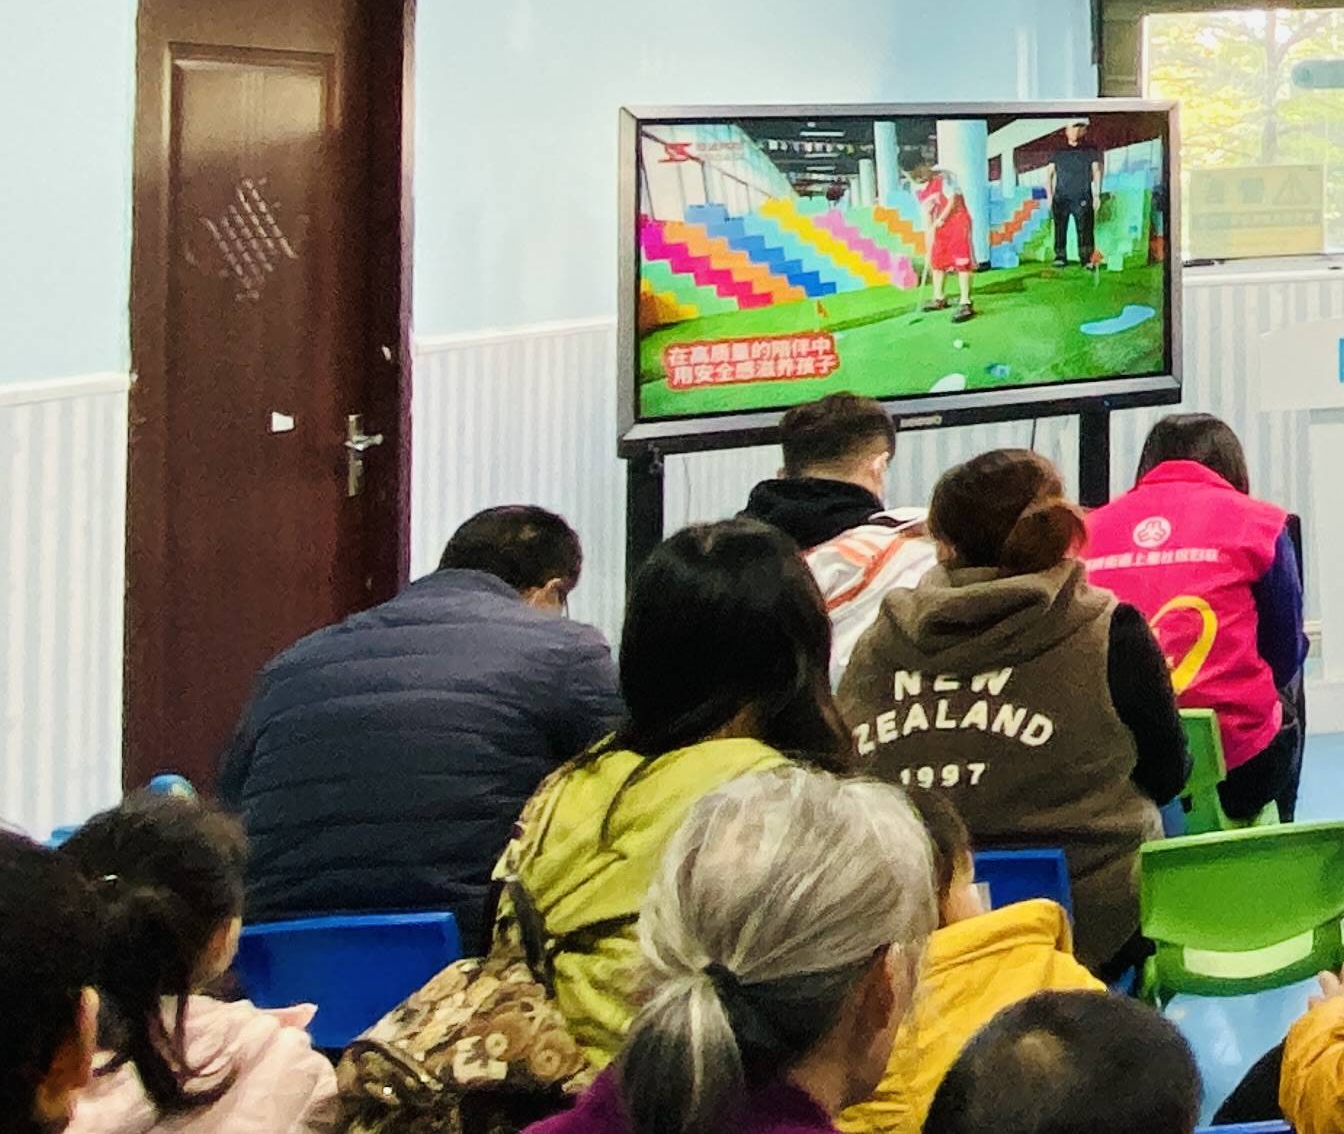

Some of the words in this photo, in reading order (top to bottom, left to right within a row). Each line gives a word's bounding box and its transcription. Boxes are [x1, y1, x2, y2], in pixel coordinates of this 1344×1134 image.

[668, 336, 832, 367] 在高质量的陪伴中
[852, 699, 1053, 755] ZEALAND
[900, 763, 986, 789] 1997
